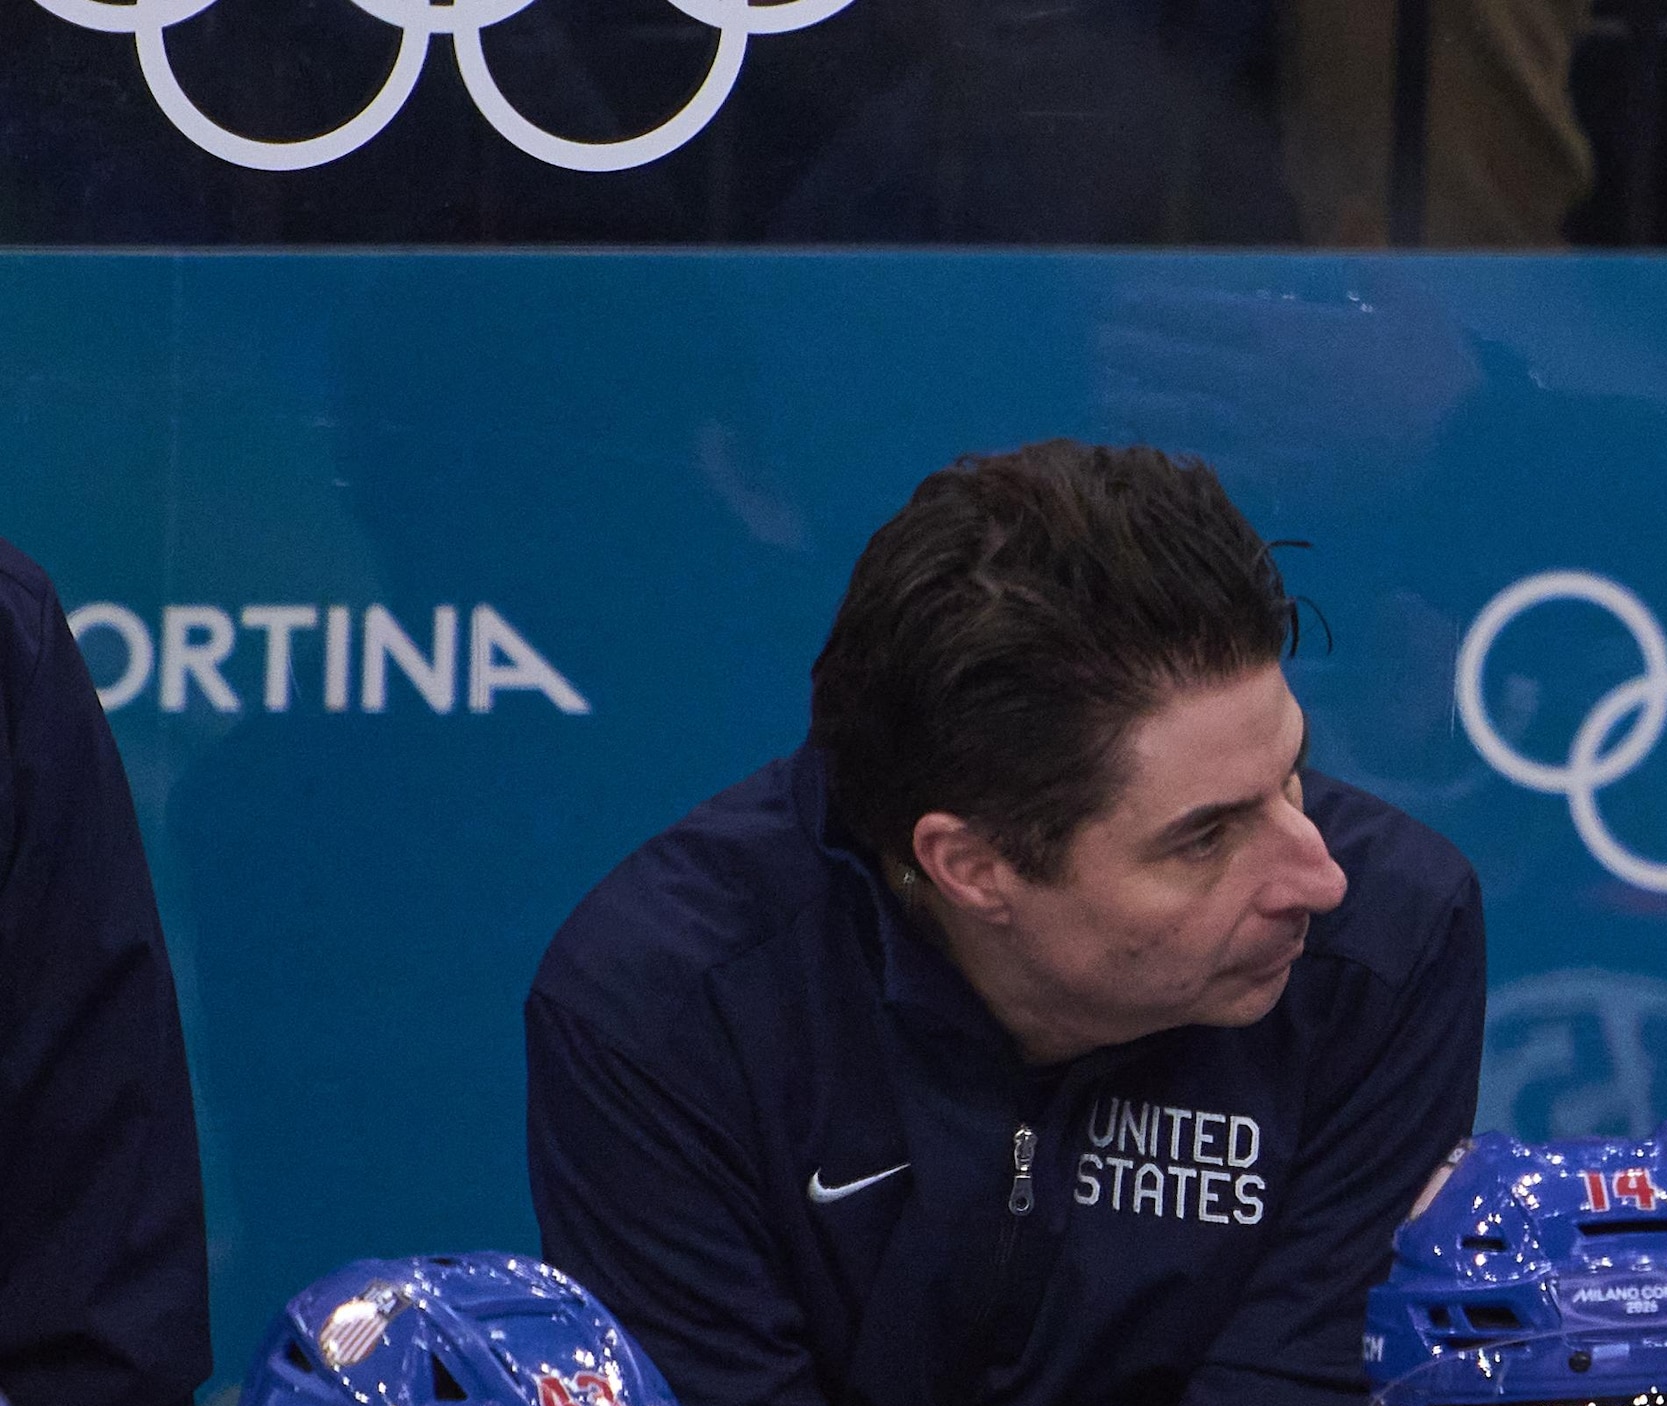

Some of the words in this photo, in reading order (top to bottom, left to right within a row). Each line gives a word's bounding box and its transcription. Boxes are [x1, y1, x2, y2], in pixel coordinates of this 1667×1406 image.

[1087, 1097, 1261, 1170] UNITED
[1073, 1153, 1267, 1226] STATES
[1580, 1167, 1659, 1212] 14
[1572, 1286, 1640, 1303] MILANO
